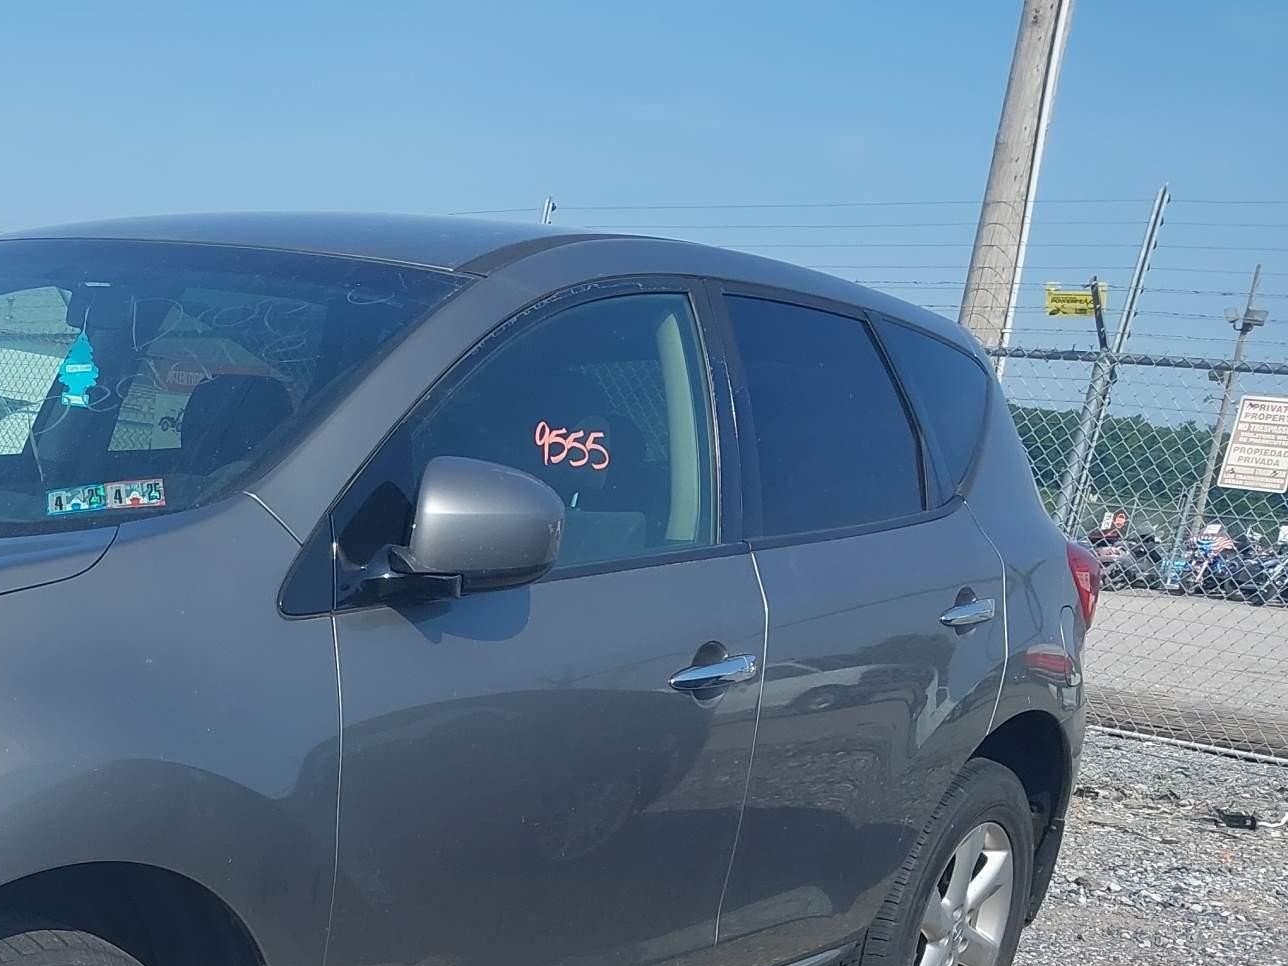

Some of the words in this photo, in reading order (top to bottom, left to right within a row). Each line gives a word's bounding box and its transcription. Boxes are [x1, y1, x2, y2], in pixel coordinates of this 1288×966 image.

[1253, 403, 1288, 413] PRIVAT
[1245, 412, 1288, 422] PROPER
[1249, 424, 1288, 434] TRESPASS
[535, 421, 609, 470] 9555
[1238, 456, 1280, 466] PRIVADA
[114, 489, 123, 504] 4
[147, 483, 161, 500] 25
[54, 496, 63, 510] 4
[87, 488, 102, 505] 25
